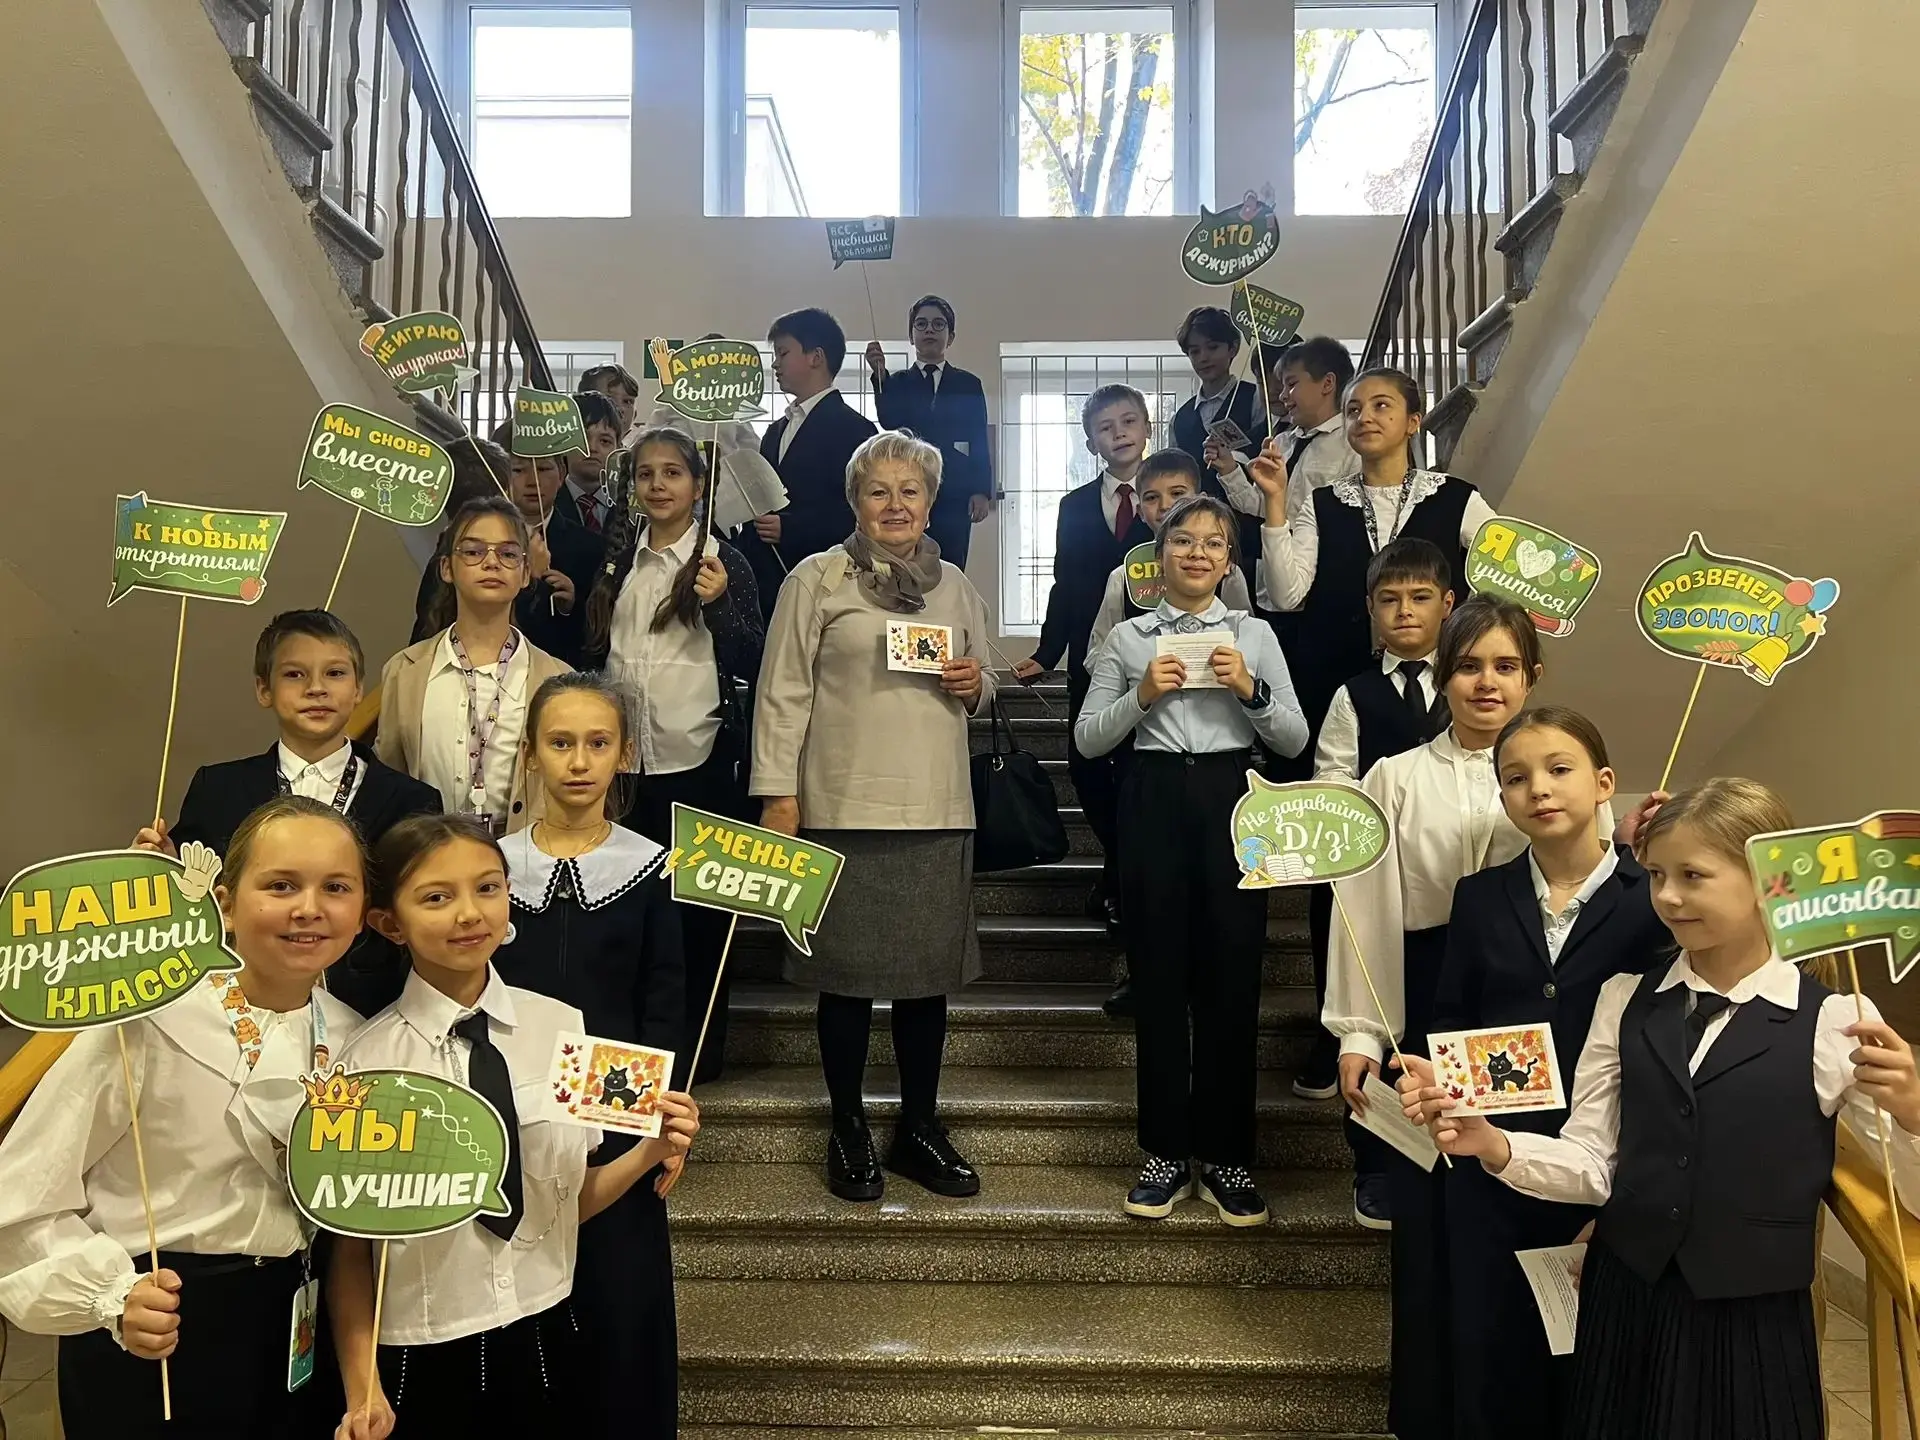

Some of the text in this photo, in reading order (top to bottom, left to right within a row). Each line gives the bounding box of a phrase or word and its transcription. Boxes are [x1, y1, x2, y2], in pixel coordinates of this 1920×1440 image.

[831, 231, 889, 253] учебники
[1212, 223, 1254, 249] КТО
[376, 324, 459, 364] НЕ ИГРАЮ
[388, 341, 467, 379] на уроках!
[672, 352, 760, 376] А МОЖНО
[672, 371, 763, 401] выйти?
[515, 415, 579, 437] отовы!
[517, 399, 569, 416] РАДИ
[312, 432, 447, 490] вместе!
[133, 522, 268, 551] К НОВЫМ
[1477, 524, 1518, 562] Я
[115, 545, 264, 572] открытиям!
[1470, 561, 1578, 615] учиться!
[1644, 567, 1785, 611] ПРОЗВЕНЕЛ
[1652, 608, 1780, 637] ЗВОНОК!
[1239, 793, 1377, 832] Не задавайте
[692, 821, 822, 878] УЧЕНЬЕ-
[1816, 835, 1860, 885] Я
[10, 873, 173, 937] НАШ
[695, 860, 803, 912] СВЕТ!
[1772, 875, 1920, 930] списыва
[0, 907, 214, 992] дружный
[45, 949, 200, 1020] КЛАСС!
[308, 1108, 418, 1153] МЫ
[309, 1172, 490, 1210] ЛУЧШИЕ!
